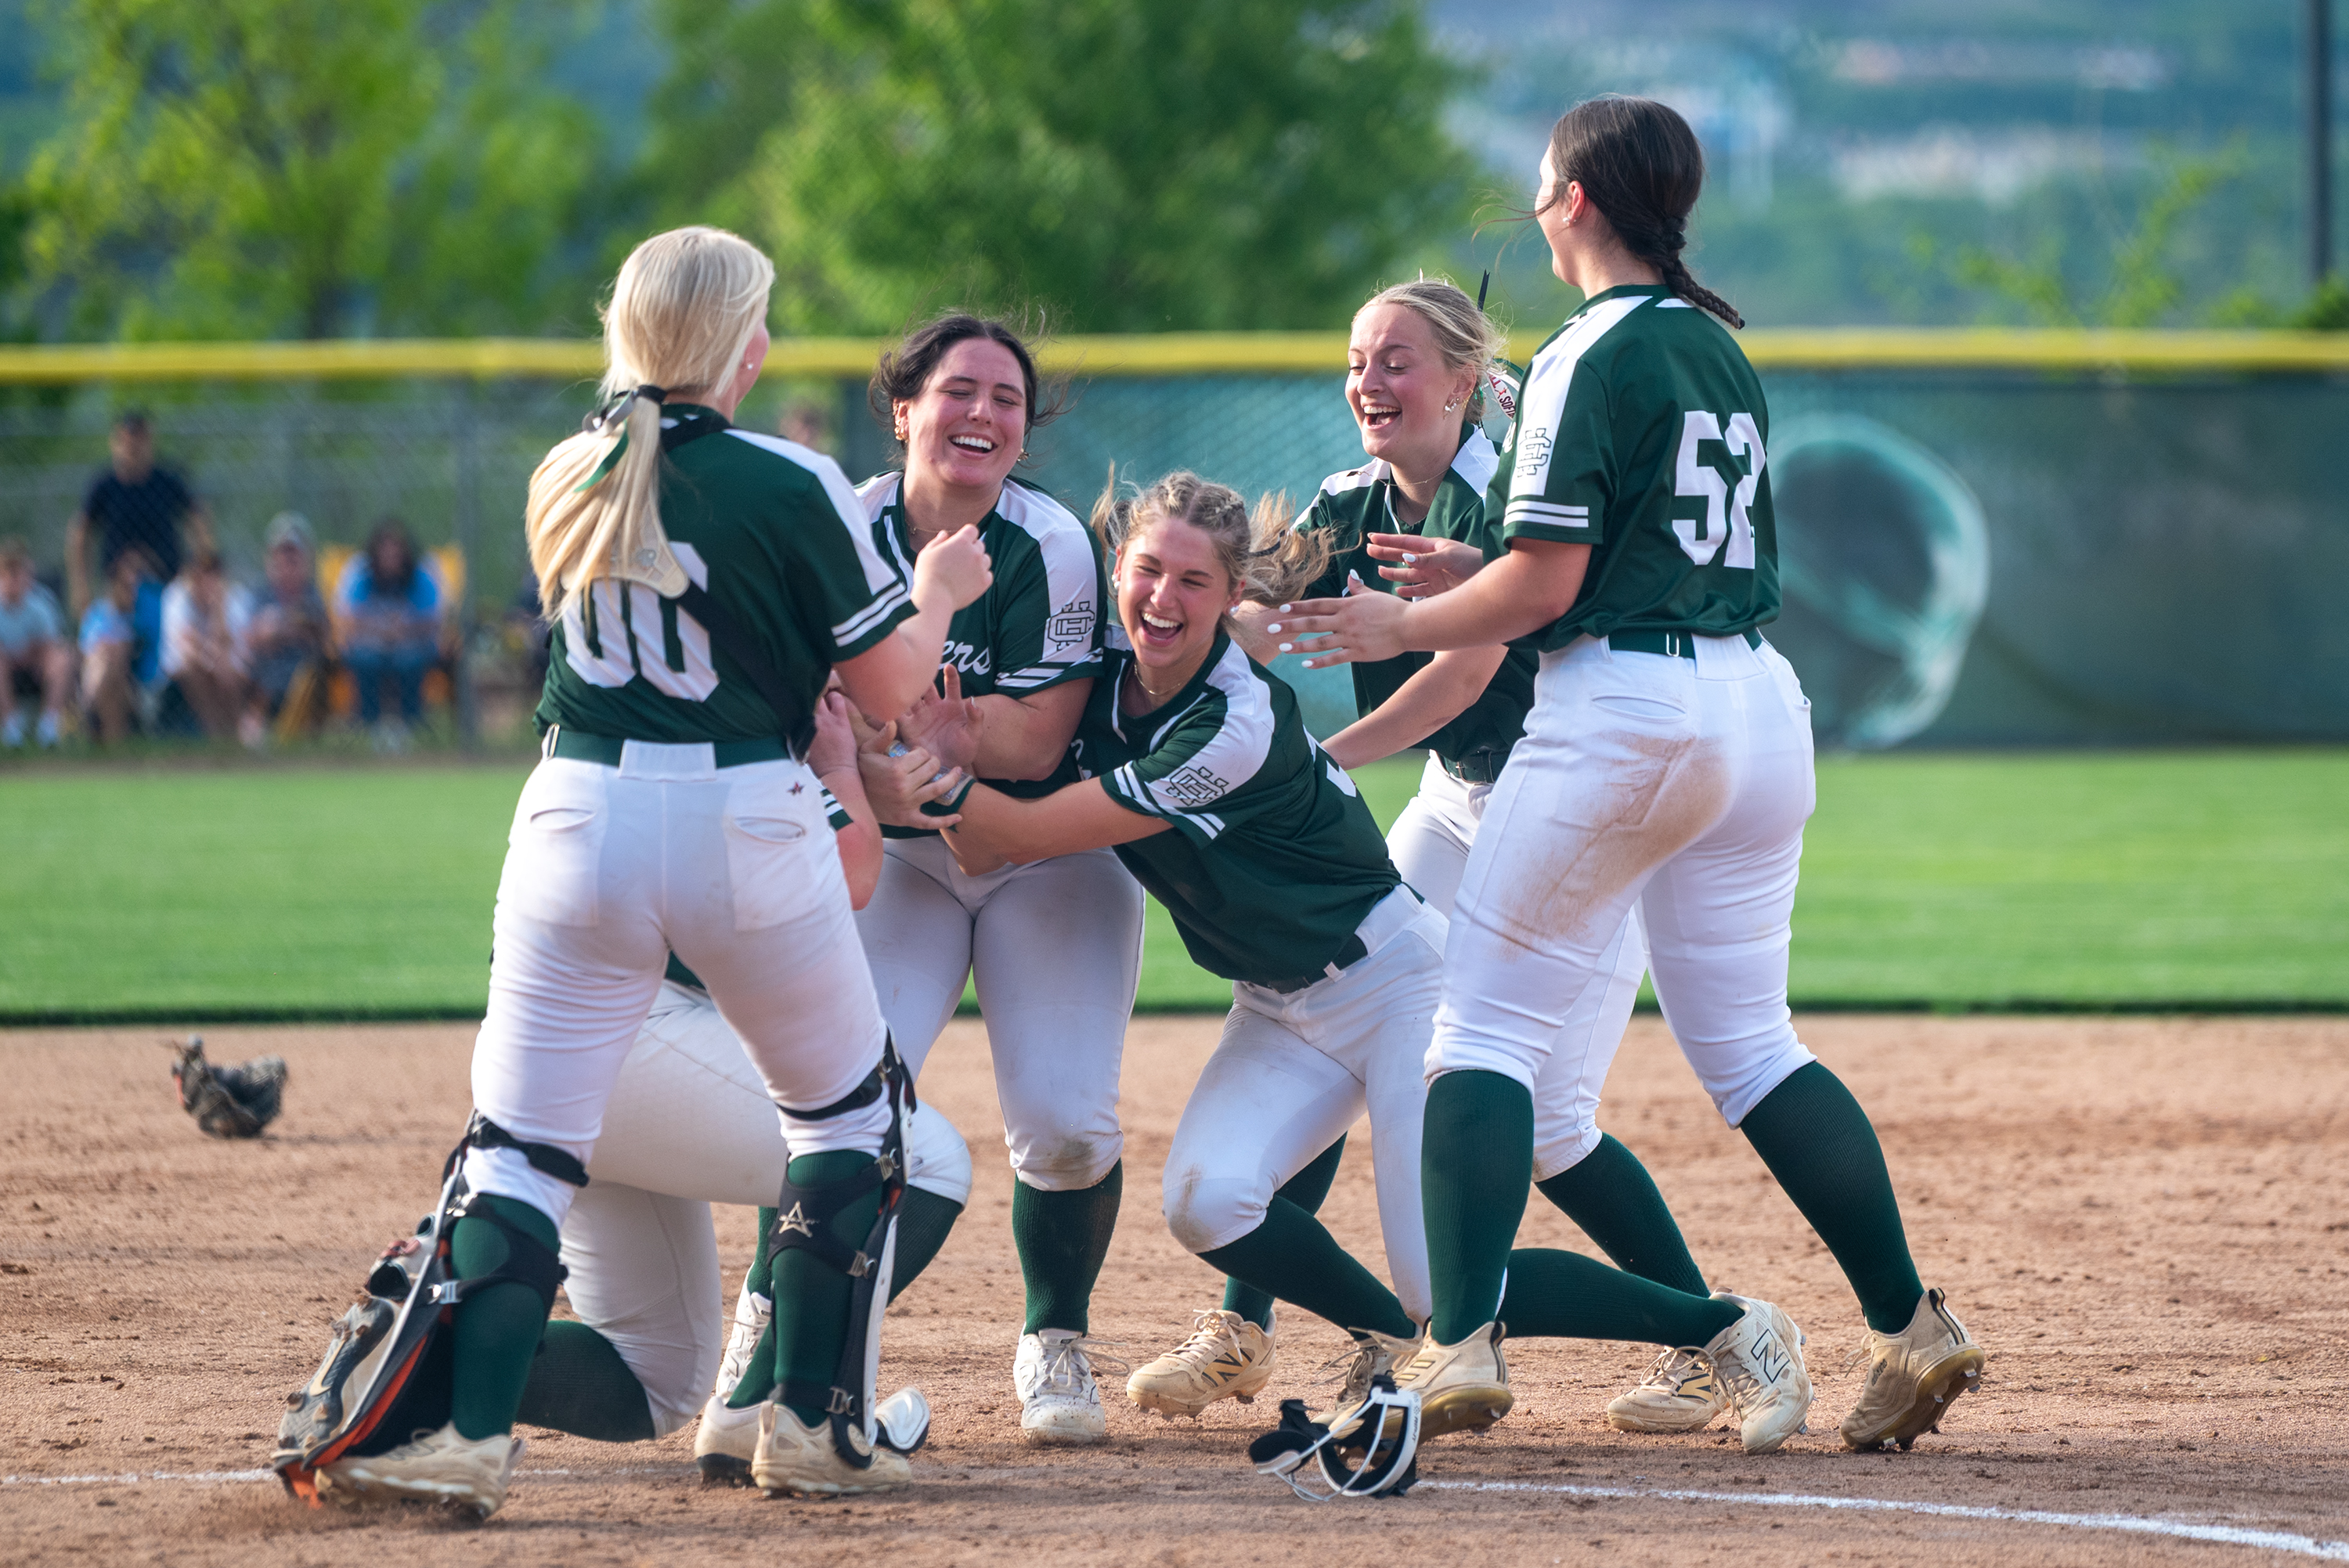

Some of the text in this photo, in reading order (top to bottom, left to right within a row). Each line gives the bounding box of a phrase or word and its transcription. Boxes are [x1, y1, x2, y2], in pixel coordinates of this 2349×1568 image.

[1672, 409, 1766, 570] 52
[561, 541, 721, 703] 00
[1750, 1328, 1791, 1384] N
